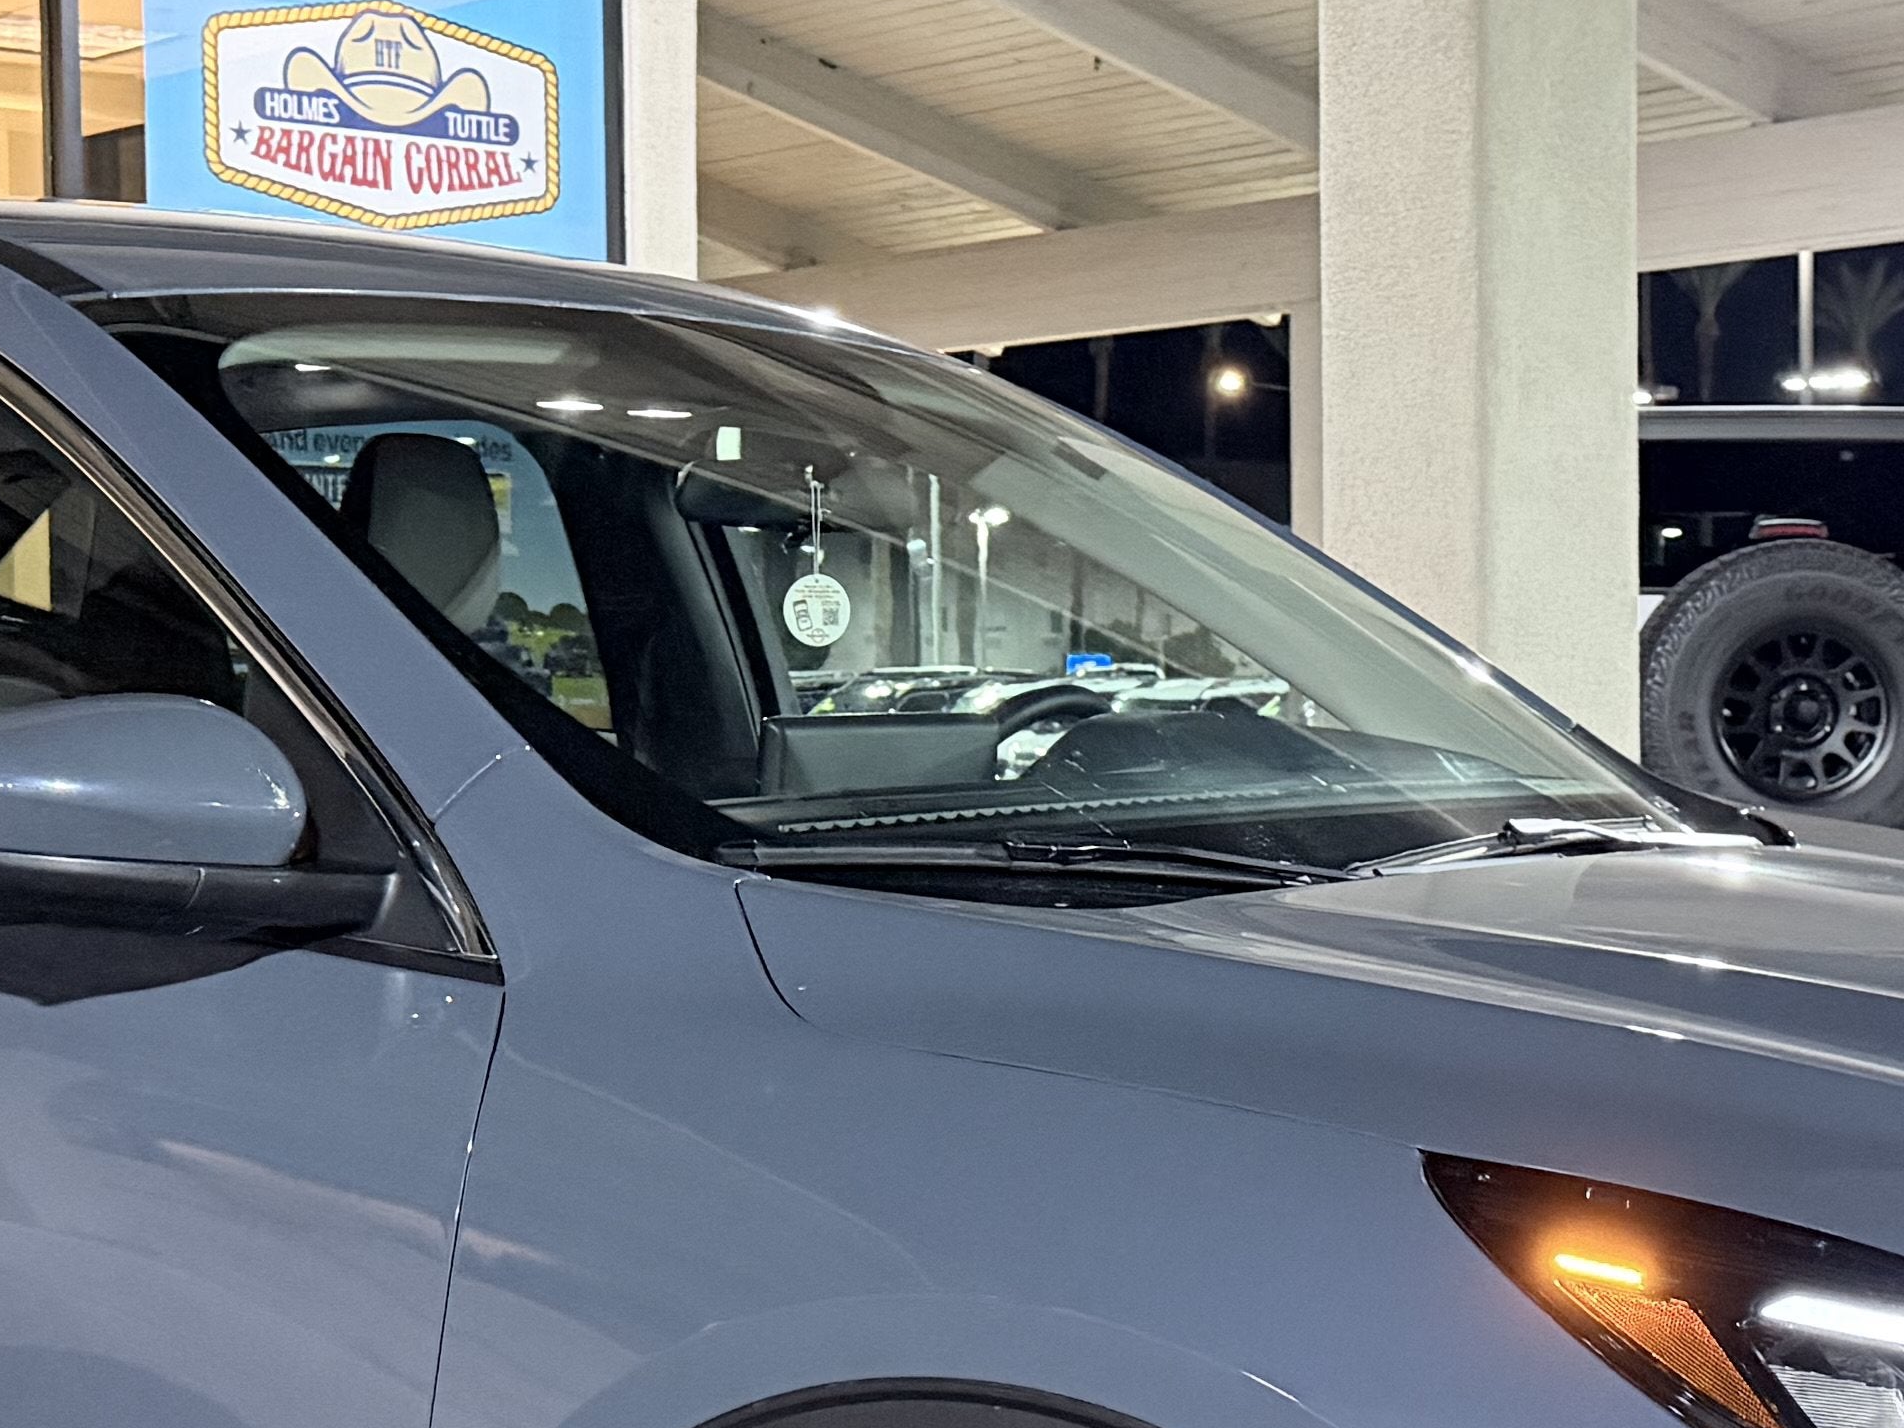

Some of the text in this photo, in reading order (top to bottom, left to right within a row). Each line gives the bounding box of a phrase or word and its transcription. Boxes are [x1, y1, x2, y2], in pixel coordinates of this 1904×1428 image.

[264, 91, 512, 143] HOLMES TUTTLE
[251, 125, 523, 195] BARGAIN CORRAL
